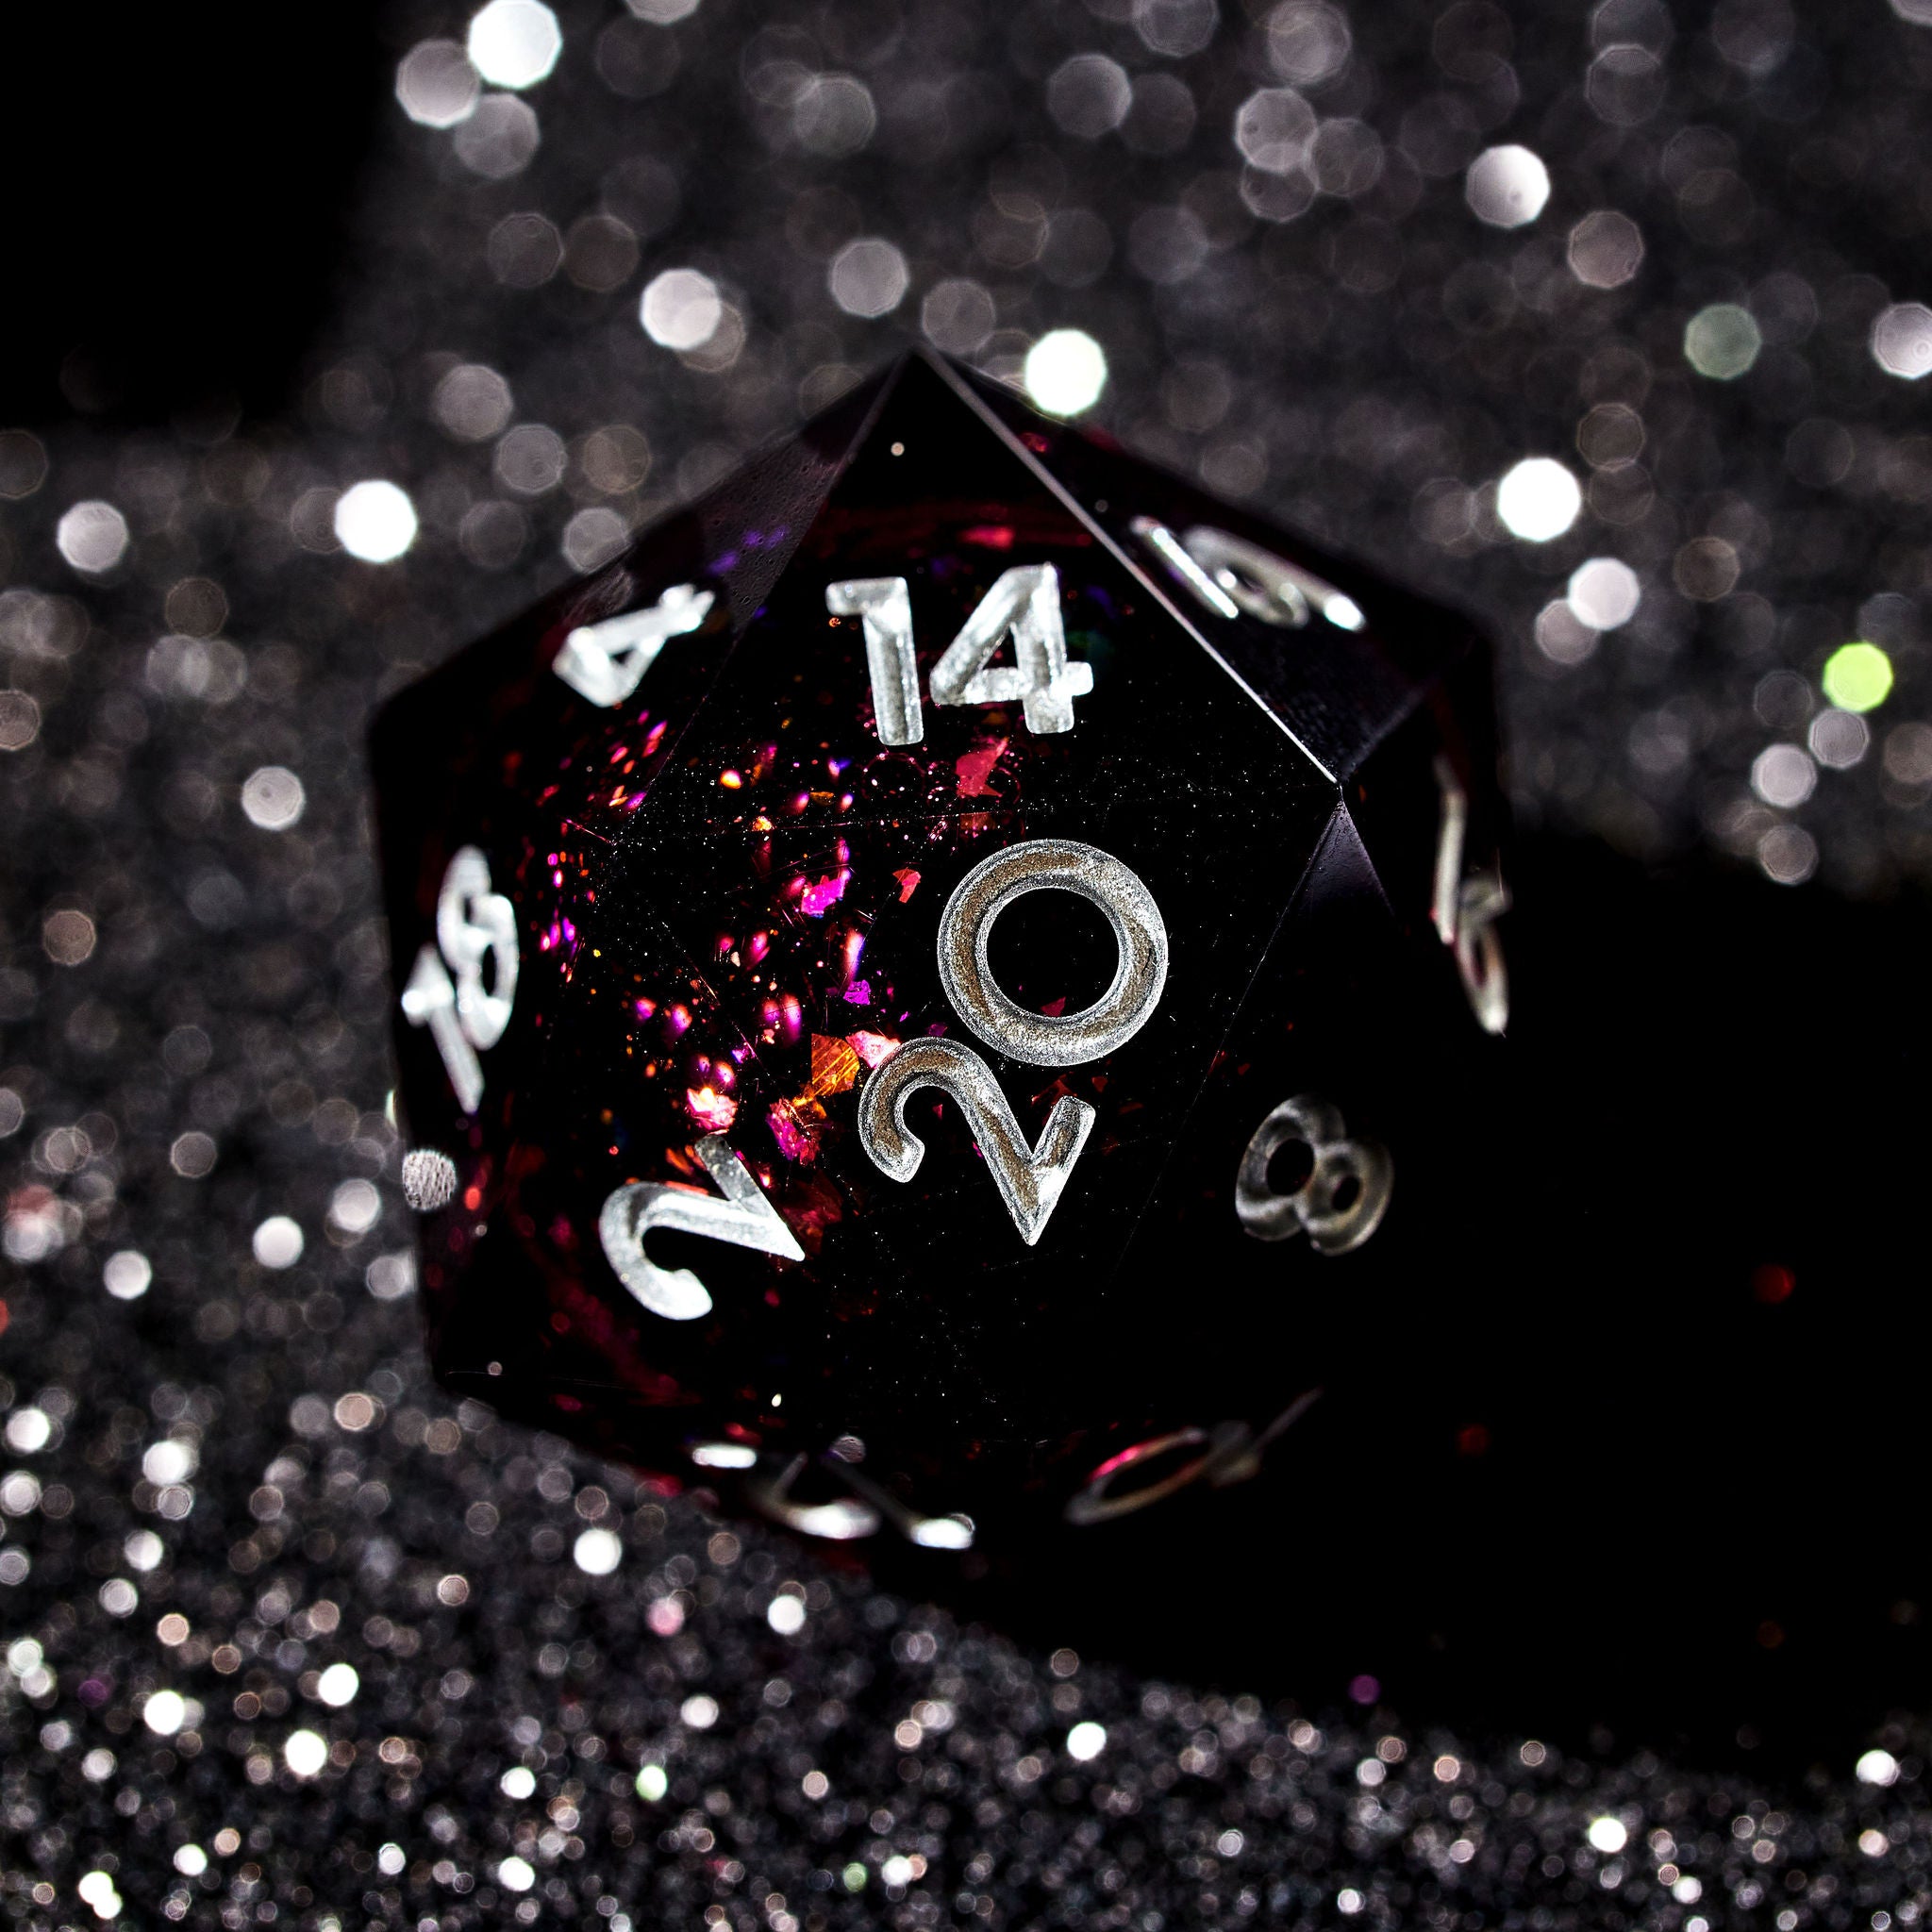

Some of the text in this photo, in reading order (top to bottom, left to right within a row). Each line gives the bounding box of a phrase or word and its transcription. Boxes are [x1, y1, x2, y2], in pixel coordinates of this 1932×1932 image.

[552, 582, 715, 708] 4
[824, 561, 1094, 745] 14
[400, 843, 520, 1115] 18
[857, 838, 1169, 1246] 20
[598, 1134, 806, 1321] 2
[1235, 1091, 1395, 1257] 8
